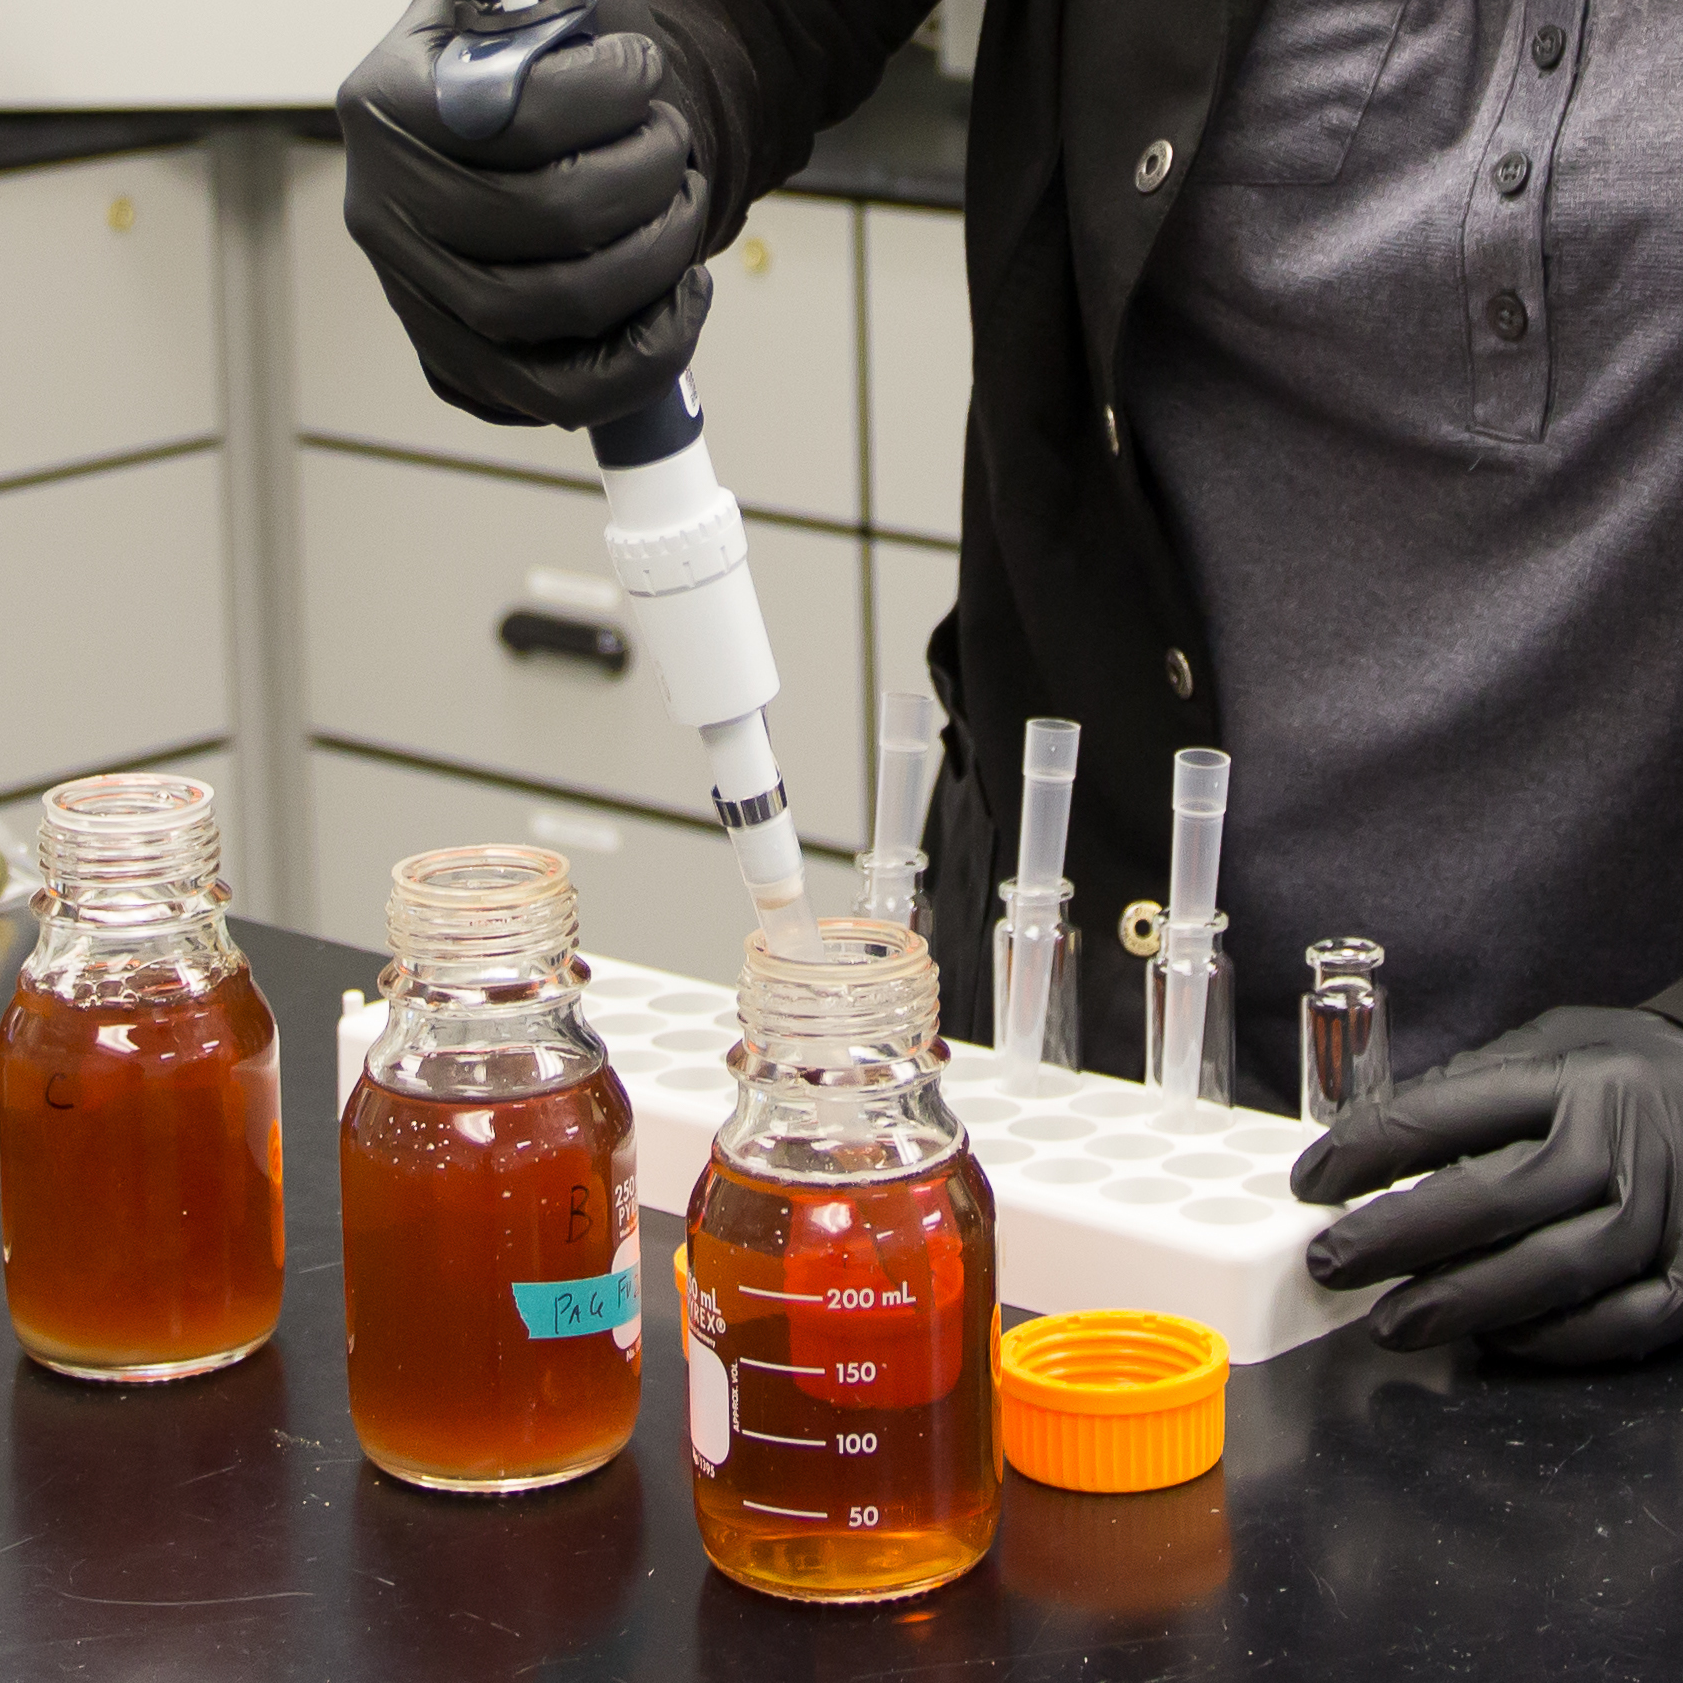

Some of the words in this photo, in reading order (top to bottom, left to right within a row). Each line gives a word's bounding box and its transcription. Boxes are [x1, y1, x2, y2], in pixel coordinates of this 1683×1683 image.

[566, 1184, 594, 1244] B
[700, 1286, 722, 1316] mL
[826, 1287, 875, 1310] 200
[881, 1279, 917, 1307] mL
[835, 1361, 877, 1384] 150
[835, 1432, 878, 1455] 100
[848, 1505, 880, 1528] 50
